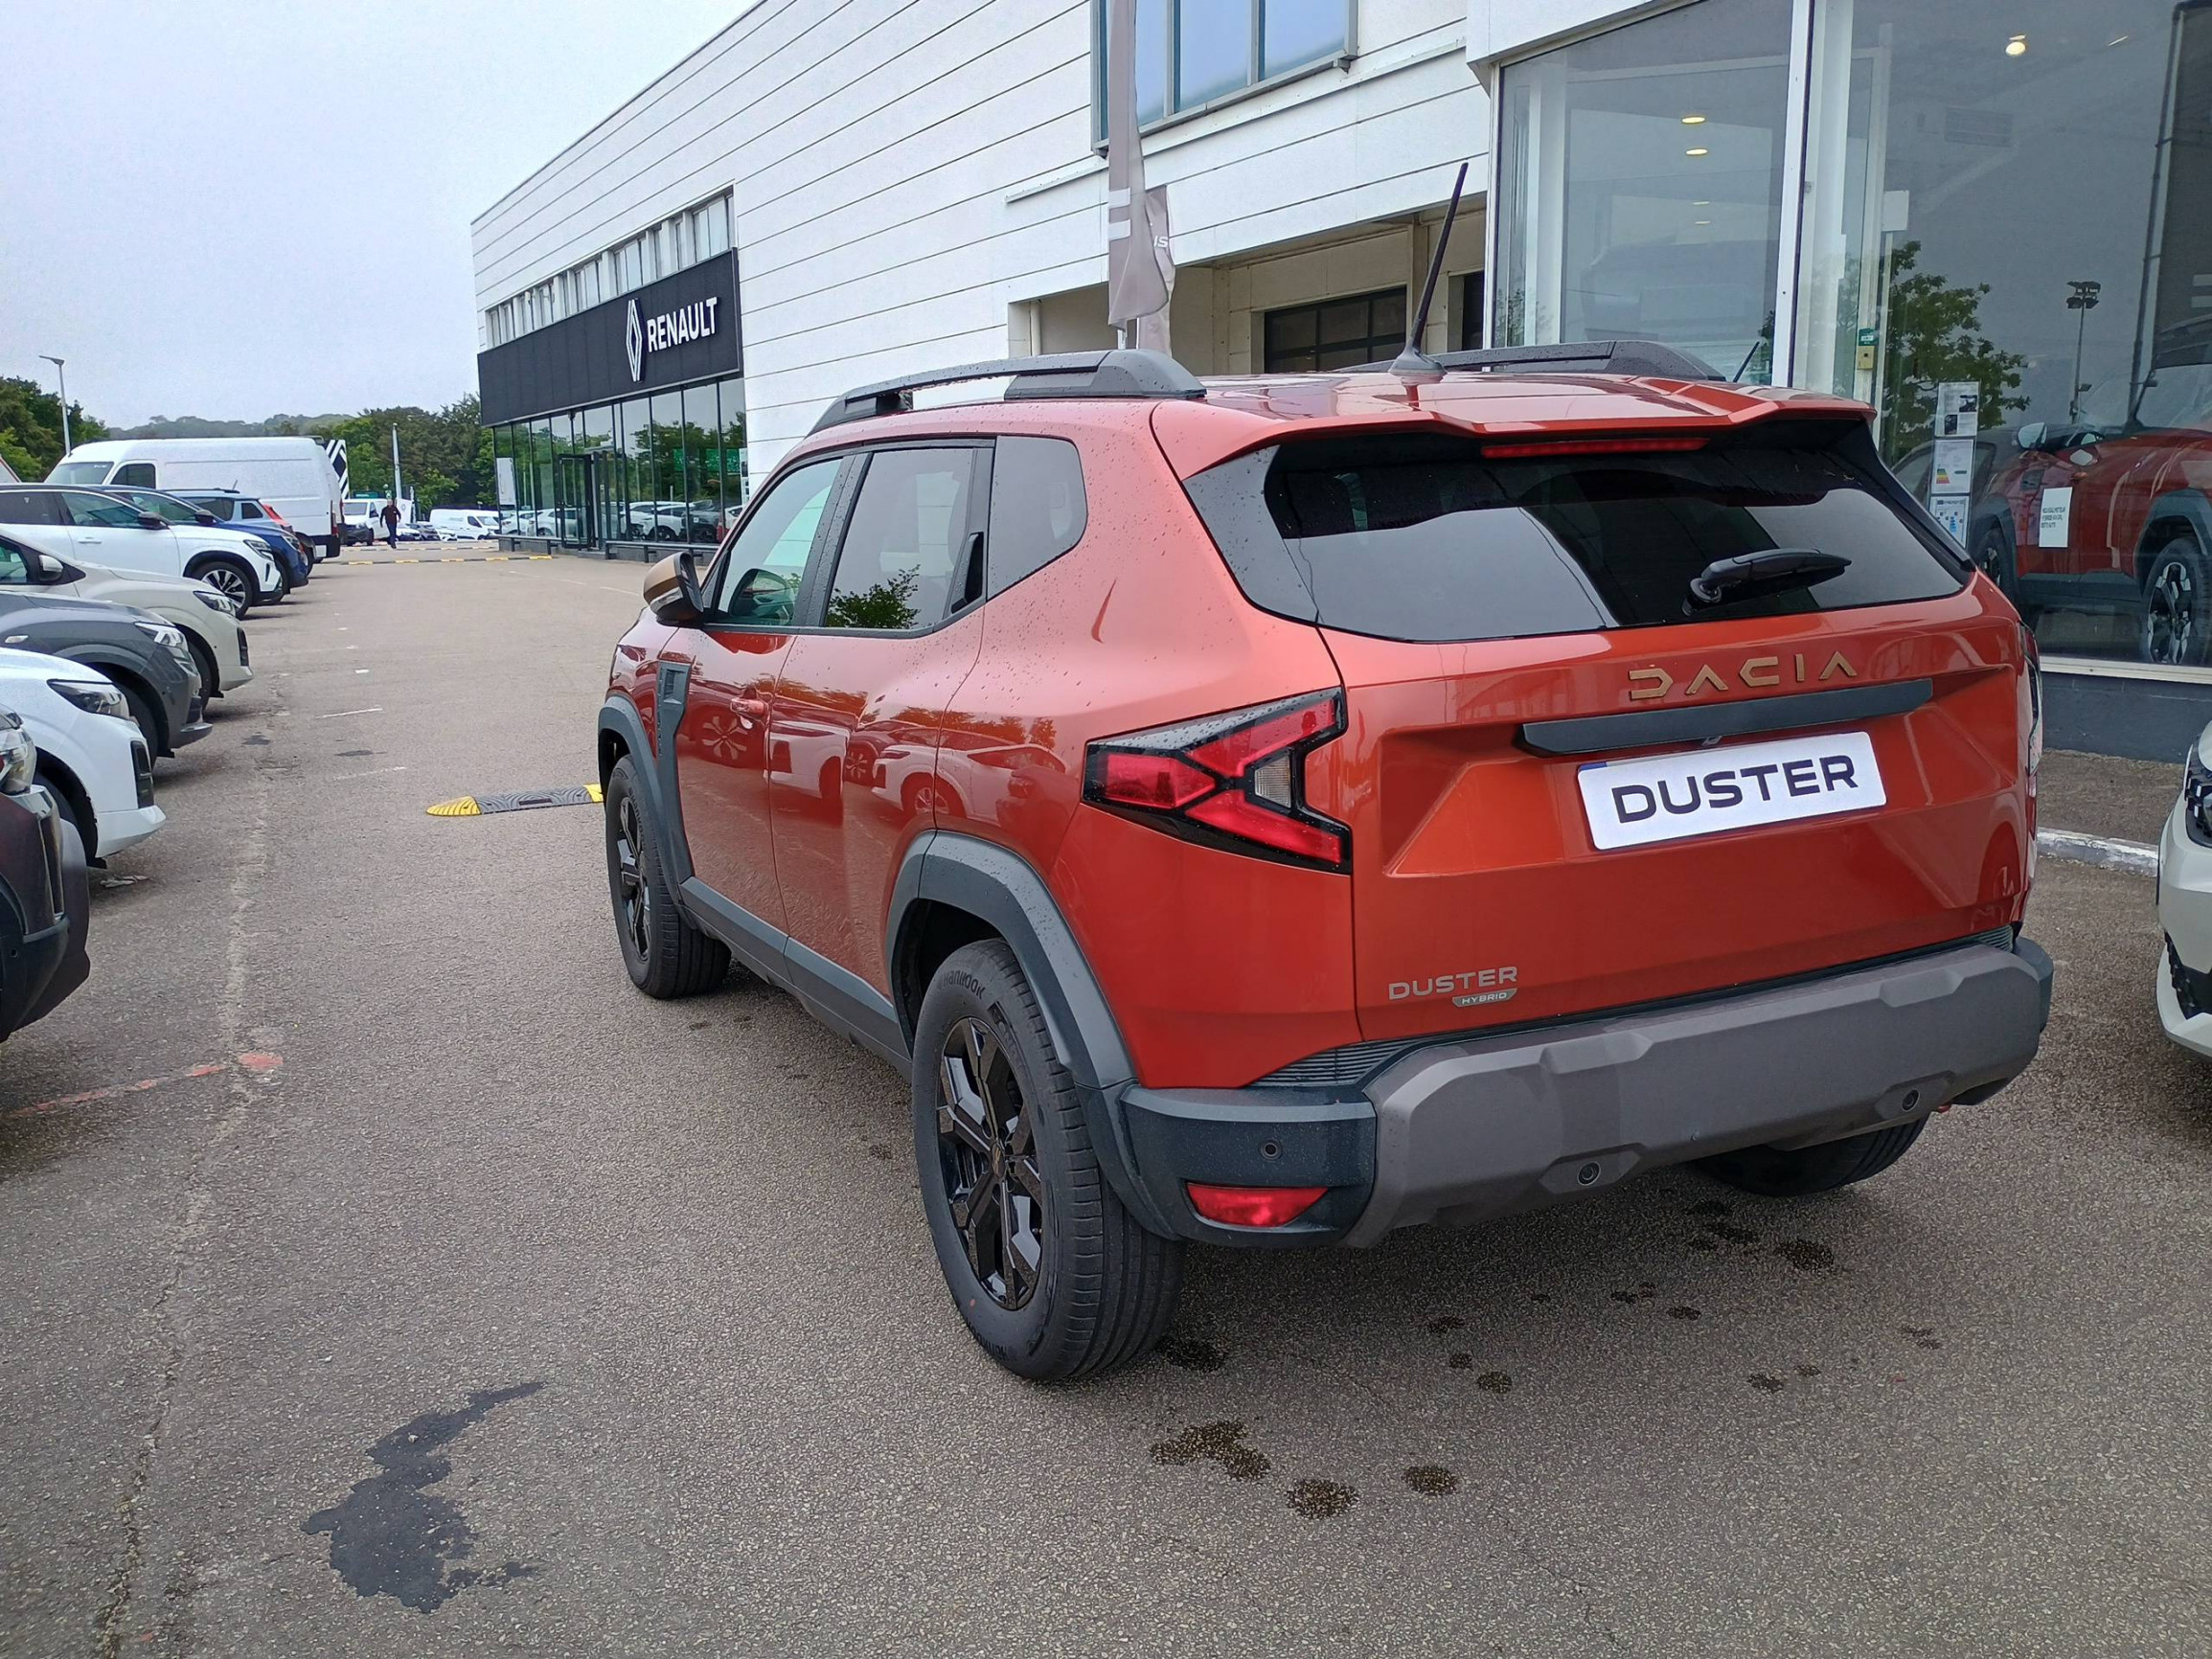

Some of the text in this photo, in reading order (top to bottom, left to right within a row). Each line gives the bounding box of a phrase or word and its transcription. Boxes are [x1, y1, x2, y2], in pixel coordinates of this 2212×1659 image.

[647, 296, 718, 352] RENAULT
[1629, 650, 1859, 700] DACIA
[1611, 755, 1859, 824] DUSTER
[1388, 966, 1517, 1000] DUSTER
[1461, 991, 1507, 1005] HYBRID
